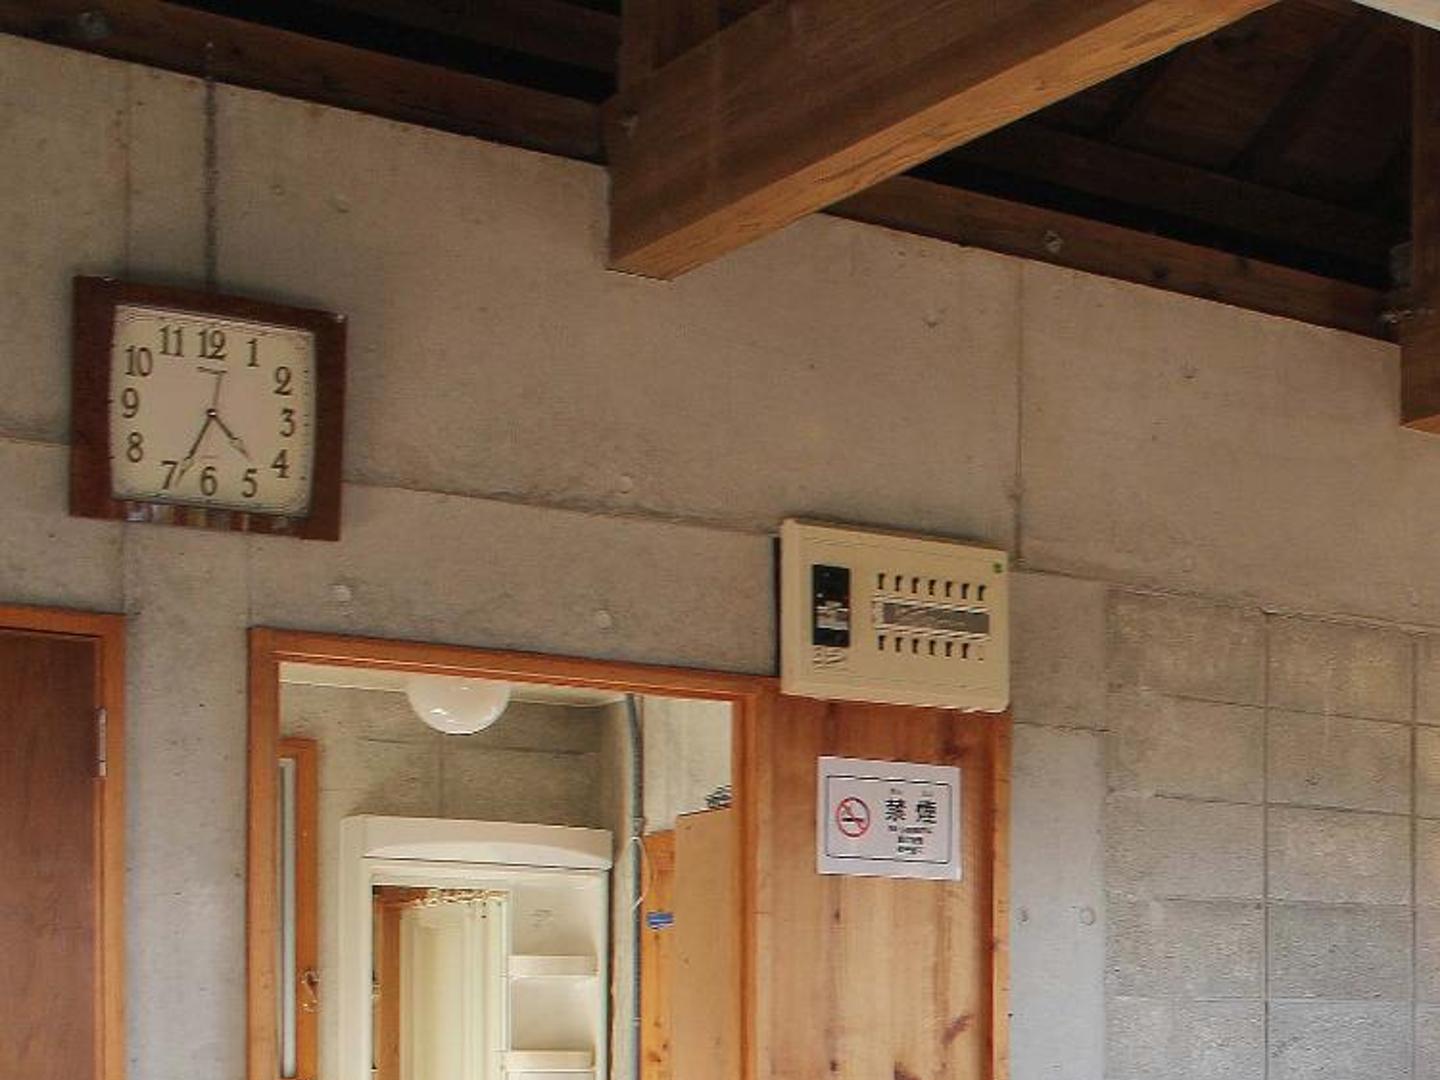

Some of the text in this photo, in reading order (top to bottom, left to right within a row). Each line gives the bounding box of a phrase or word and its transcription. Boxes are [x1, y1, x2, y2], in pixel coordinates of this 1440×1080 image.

[159, 325, 185, 357] 11
[197, 328, 228, 360] 12
[246, 338, 260, 367] 1
[124, 345, 153, 377] 10
[273, 366, 292, 396] 2
[121, 388, 139, 418] 9
[279, 409, 295, 438] 3
[126, 432, 143, 463] 8
[160, 460, 178, 490] 7
[270, 450, 290, 478] 4
[200, 466, 217, 496] 6
[241, 468, 258, 498] 5
